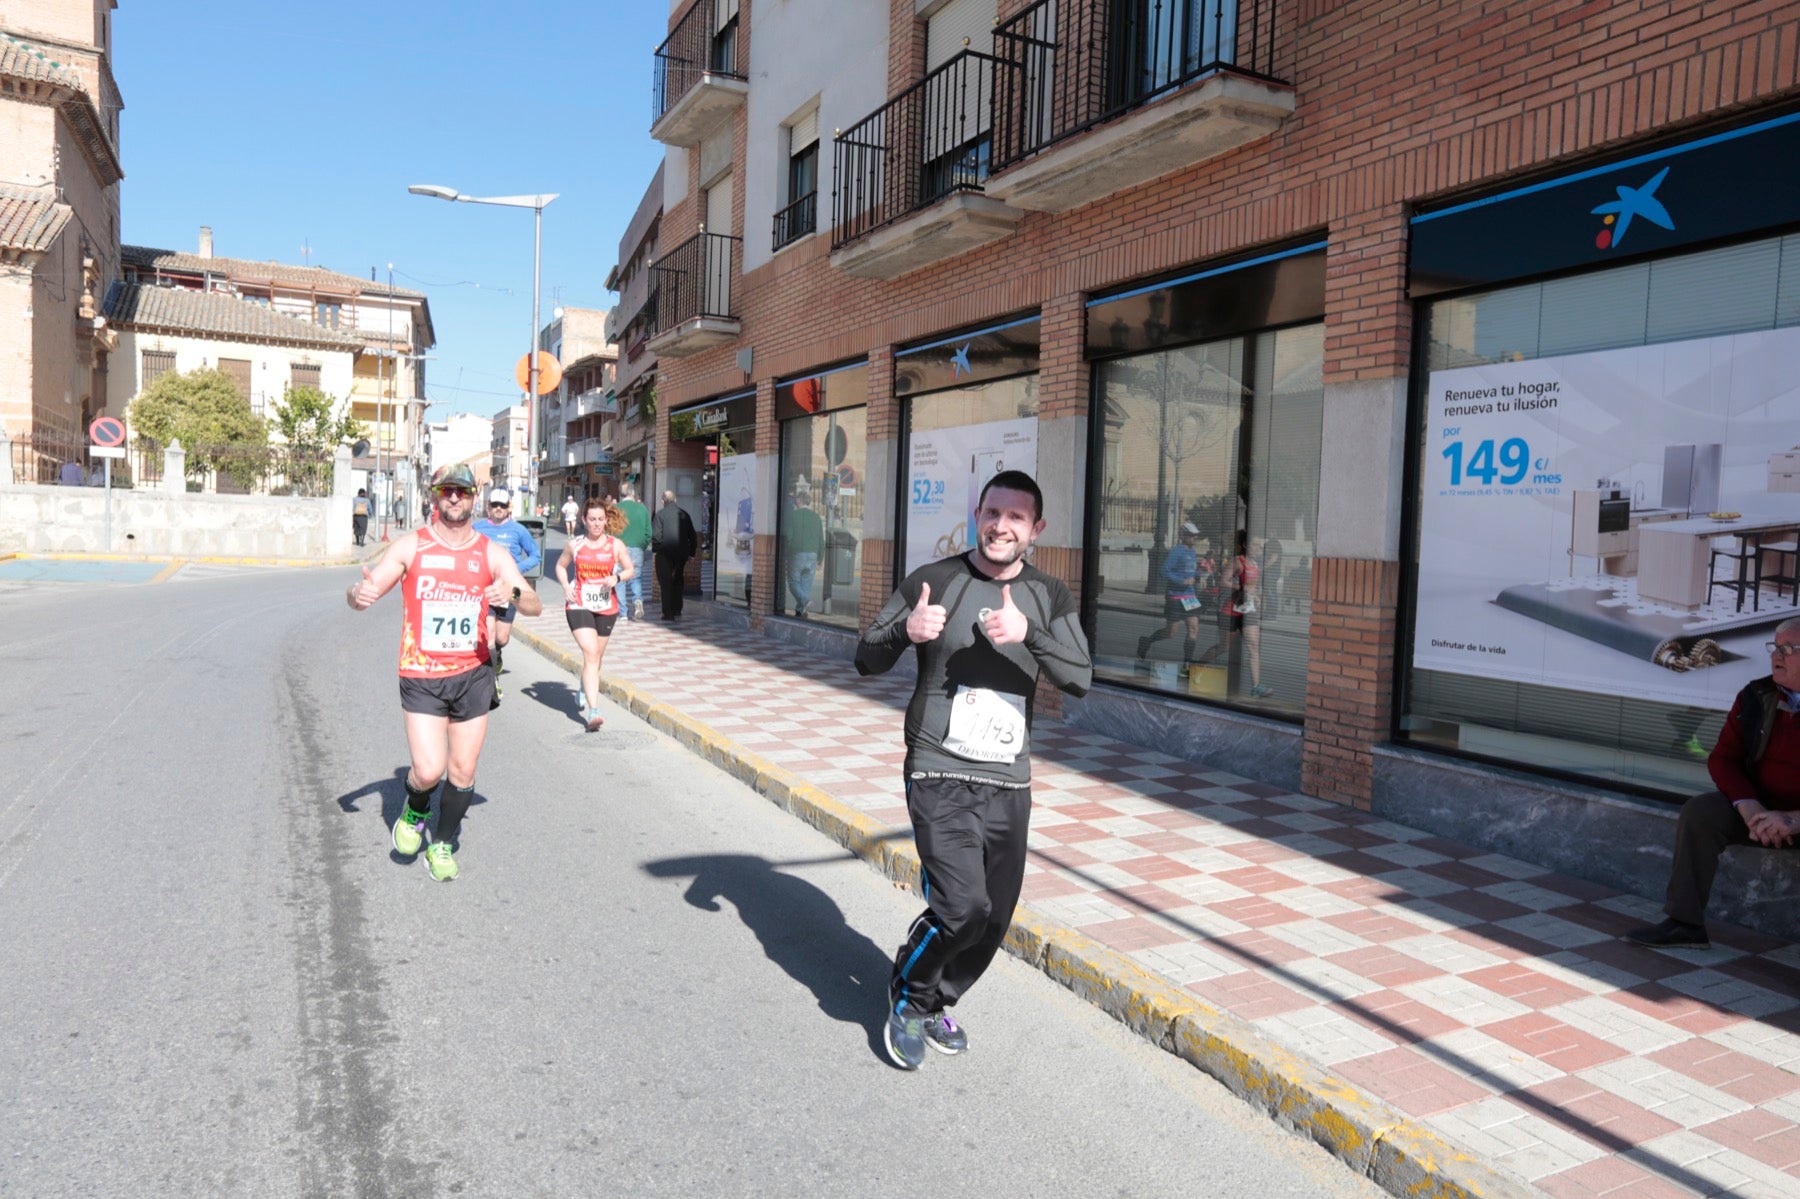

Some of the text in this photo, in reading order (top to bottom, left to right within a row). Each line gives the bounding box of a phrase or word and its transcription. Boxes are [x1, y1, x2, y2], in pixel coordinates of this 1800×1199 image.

[1445, 381, 1560, 402] Renueva tu hogar,
[1444, 396, 1558, 416] renueva tu ilusión
[1443, 427, 1461, 439] por
[1442, 438, 1530, 486] 149
[1533, 474, 1562, 484] mes
[416, 576, 484, 602] Polisalud
[432, 618, 470, 636] 716
[1432, 639, 1464, 650] Disfrutar
[1488, 646, 1506, 654] vida
[942, 772, 970, 781] running
[971, 776, 1004, 786] experience
